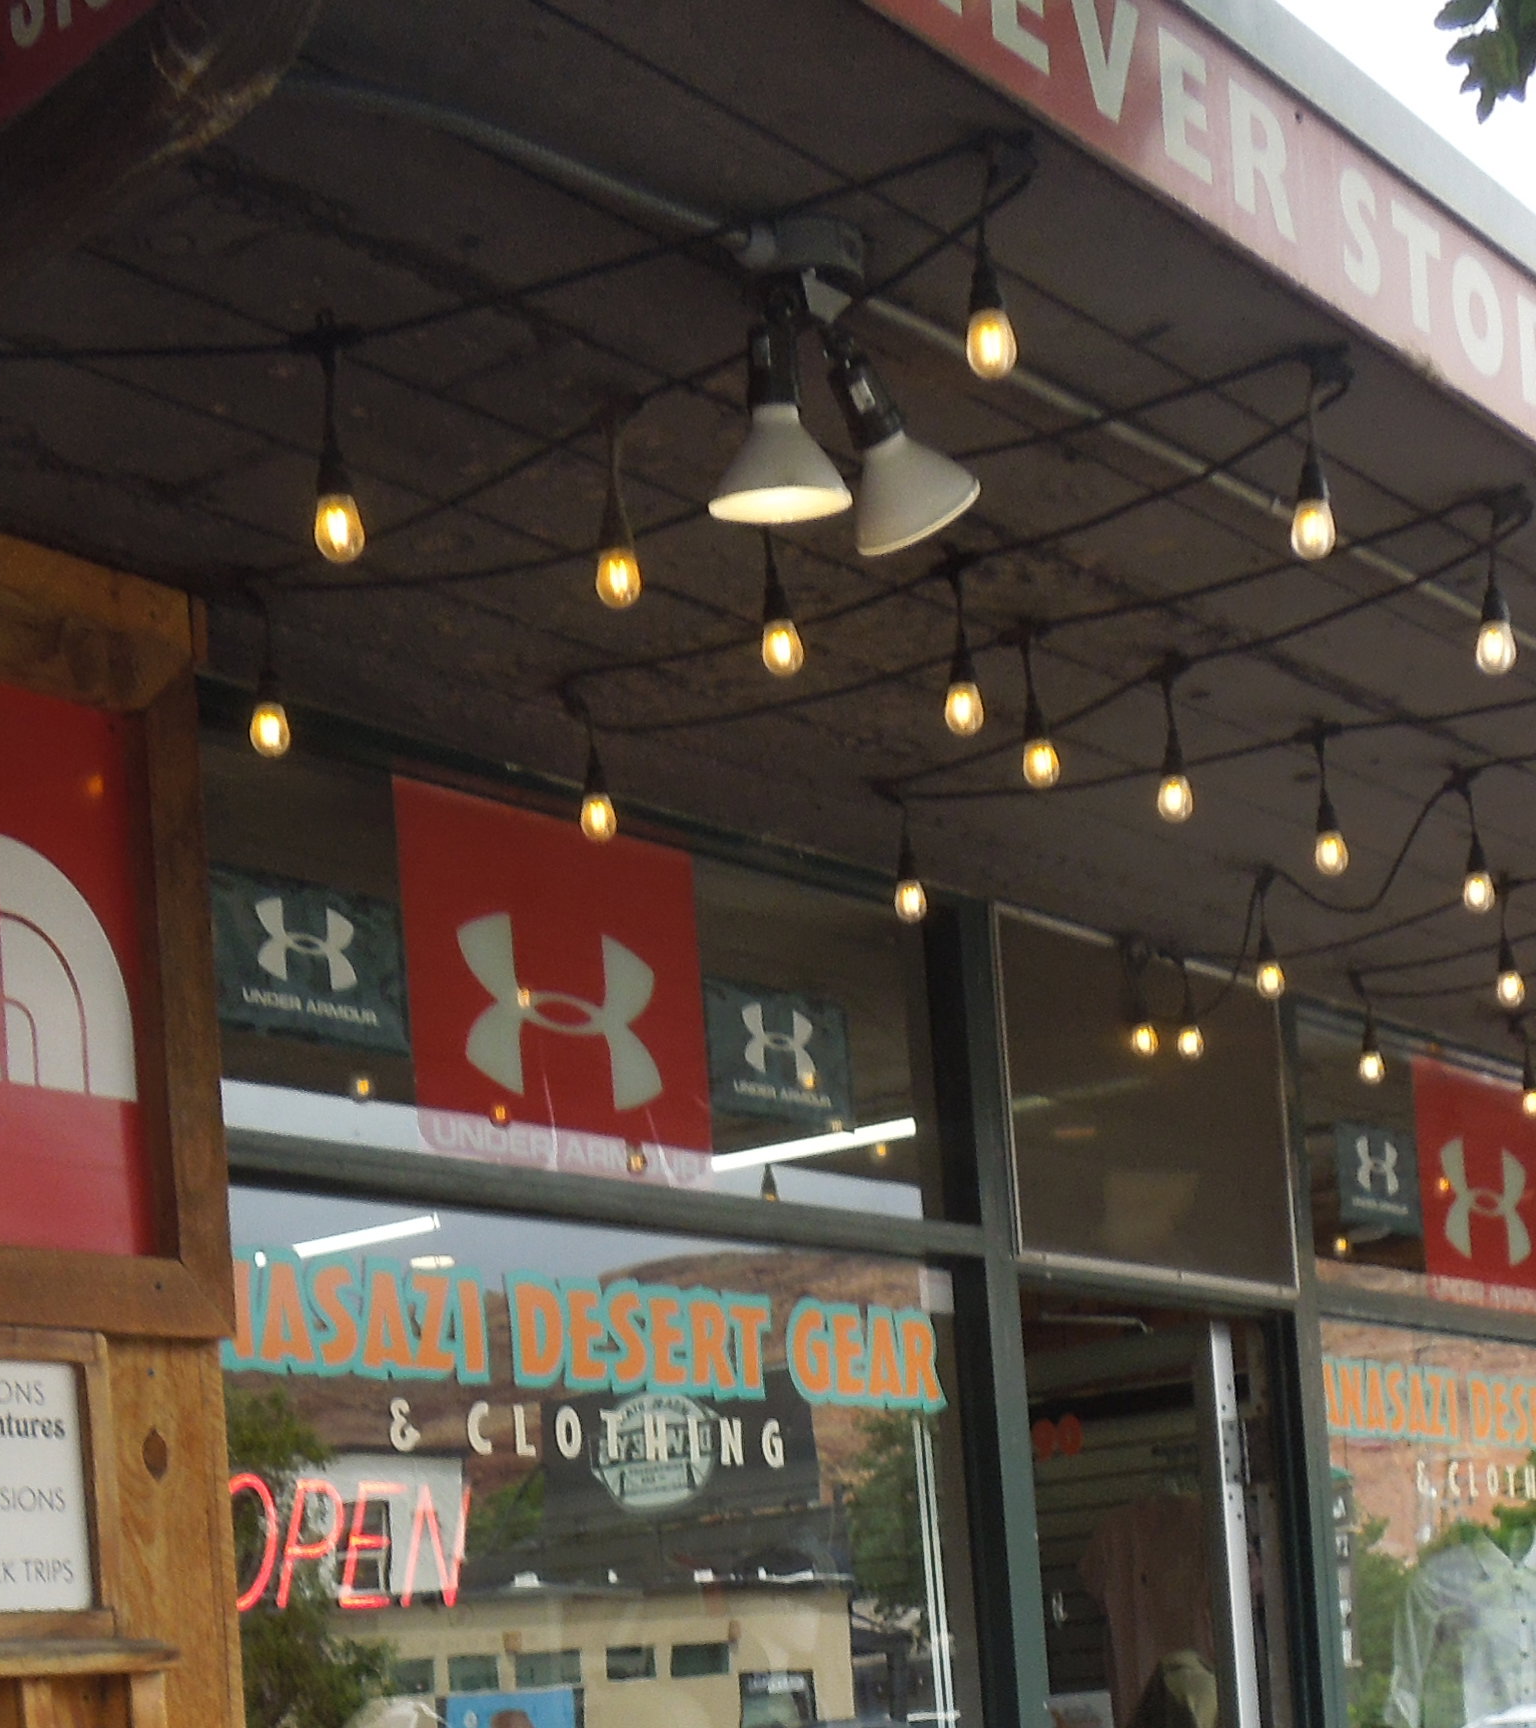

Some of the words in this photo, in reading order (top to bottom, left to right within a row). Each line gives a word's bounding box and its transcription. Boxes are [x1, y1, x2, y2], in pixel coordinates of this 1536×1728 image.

[939, 0, 1297, 244] EVER
[433, 1116, 553, 1162] UNDER
[504, 1267, 770, 1402] DESERT
[788, 1298, 946, 1413] GEAR
[390, 1397, 421, 1452] &
[467, 1402, 785, 1469] CLOTHING
[24, 1559, 74, 1585] TRIPS
